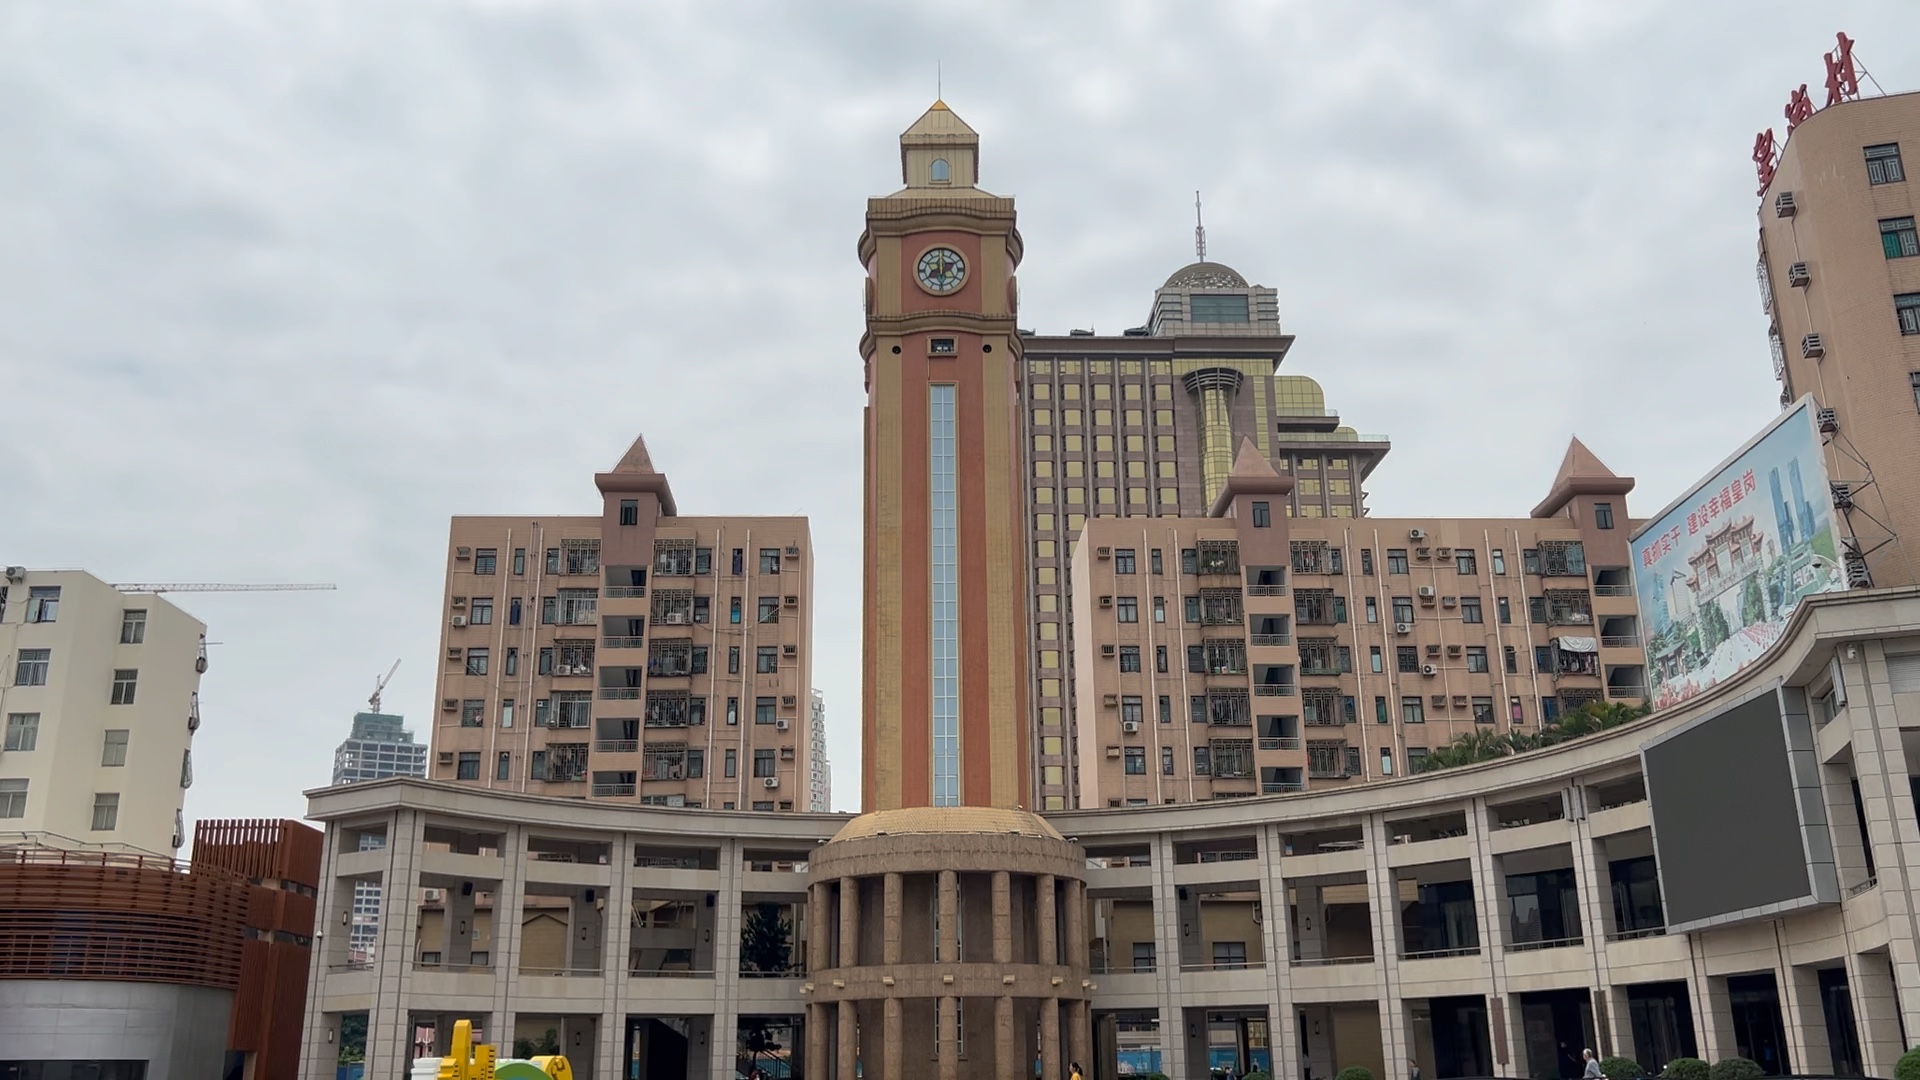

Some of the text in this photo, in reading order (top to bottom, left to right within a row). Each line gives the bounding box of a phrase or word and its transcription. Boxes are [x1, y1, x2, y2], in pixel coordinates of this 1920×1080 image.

[1641, 467, 1757, 569] 真抓实干 建设幸福皇岗
